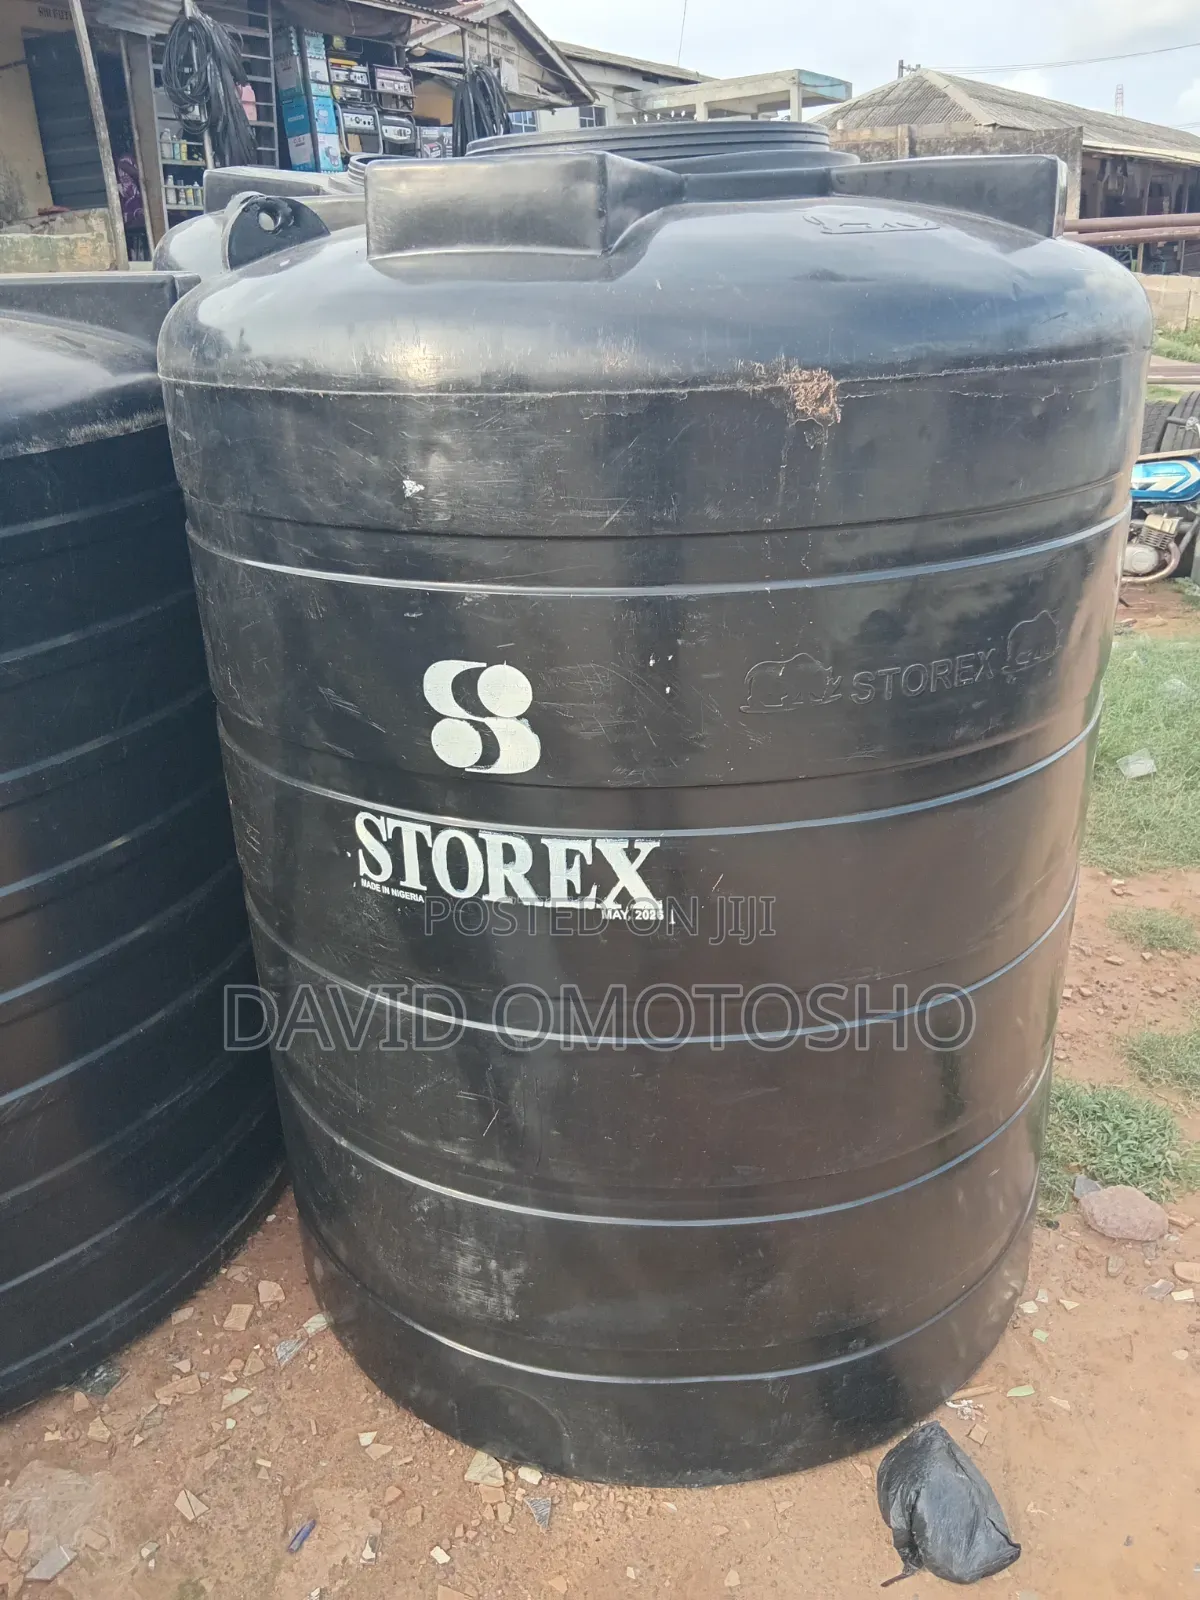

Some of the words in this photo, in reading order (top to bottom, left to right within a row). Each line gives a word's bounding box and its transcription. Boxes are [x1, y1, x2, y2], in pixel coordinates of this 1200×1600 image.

[851, 648, 997, 704] STOREX
[354, 810, 663, 909] STOREX
[361, 878, 381, 893] MADE
[382, 885, 390, 895] IN
[391, 887, 425, 904] NIGERIA
